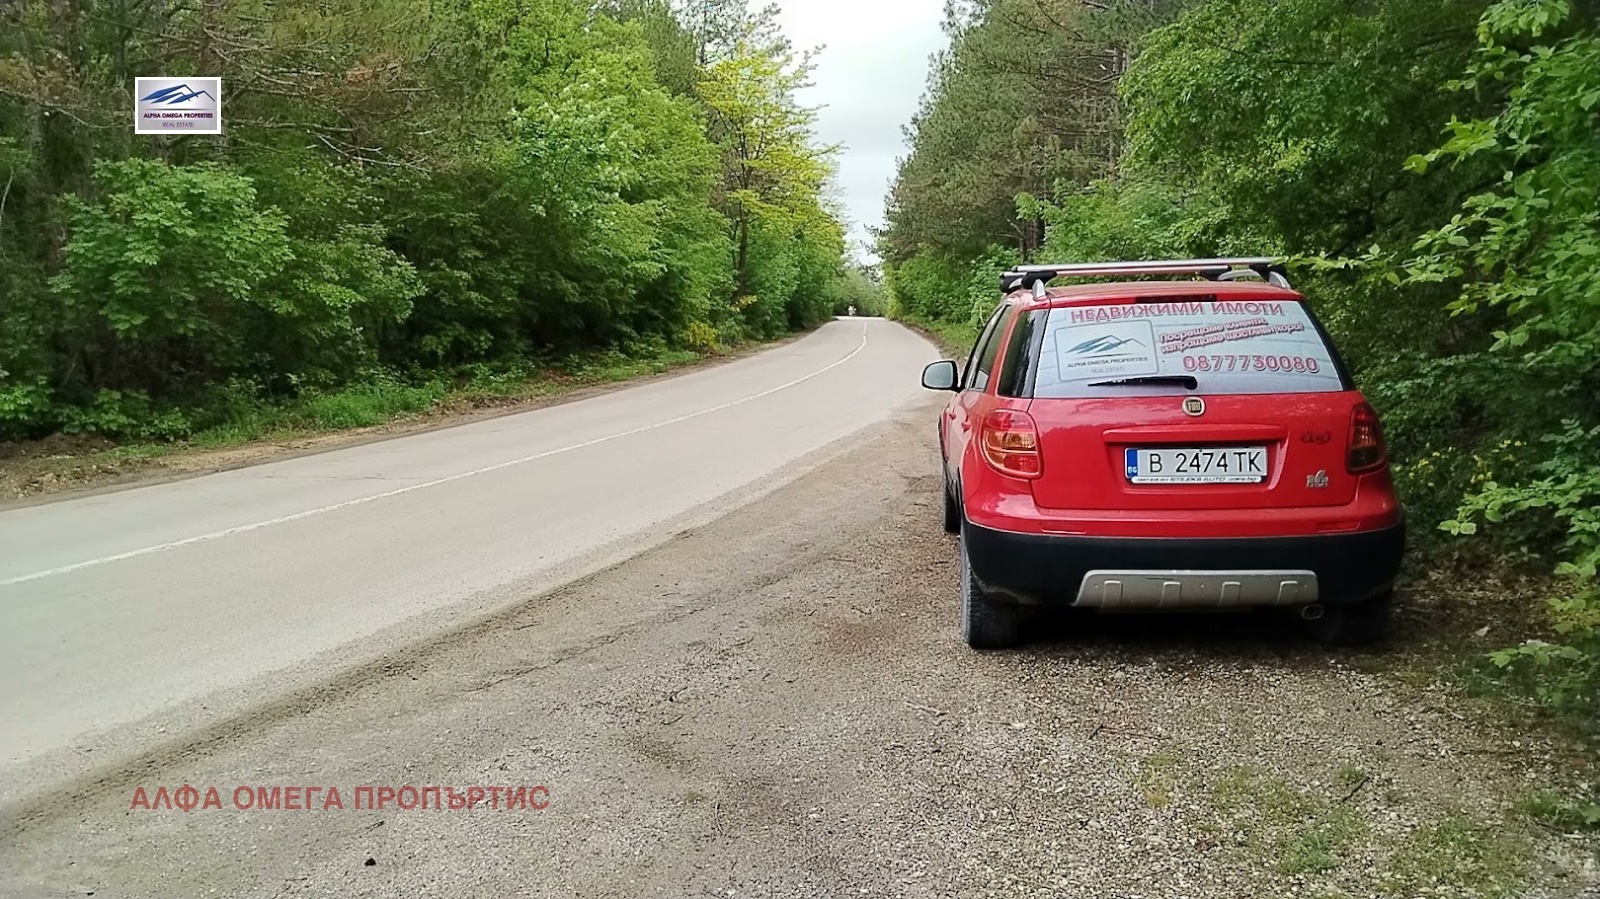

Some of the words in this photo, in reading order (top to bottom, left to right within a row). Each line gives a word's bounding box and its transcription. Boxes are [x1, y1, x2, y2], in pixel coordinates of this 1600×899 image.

[1070, 303, 1205, 323] НЕДВИЖИМИ
[1212, 302, 1285, 316] ИМОТИ
[1110, 356, 1148, 364] PROPERTIES
[1183, 355, 1320, 373] 0877730080
[1187, 401, 1202, 411] FIAT
[1175, 452, 1229, 473] 2474
[1127, 466, 1138, 474] BG
